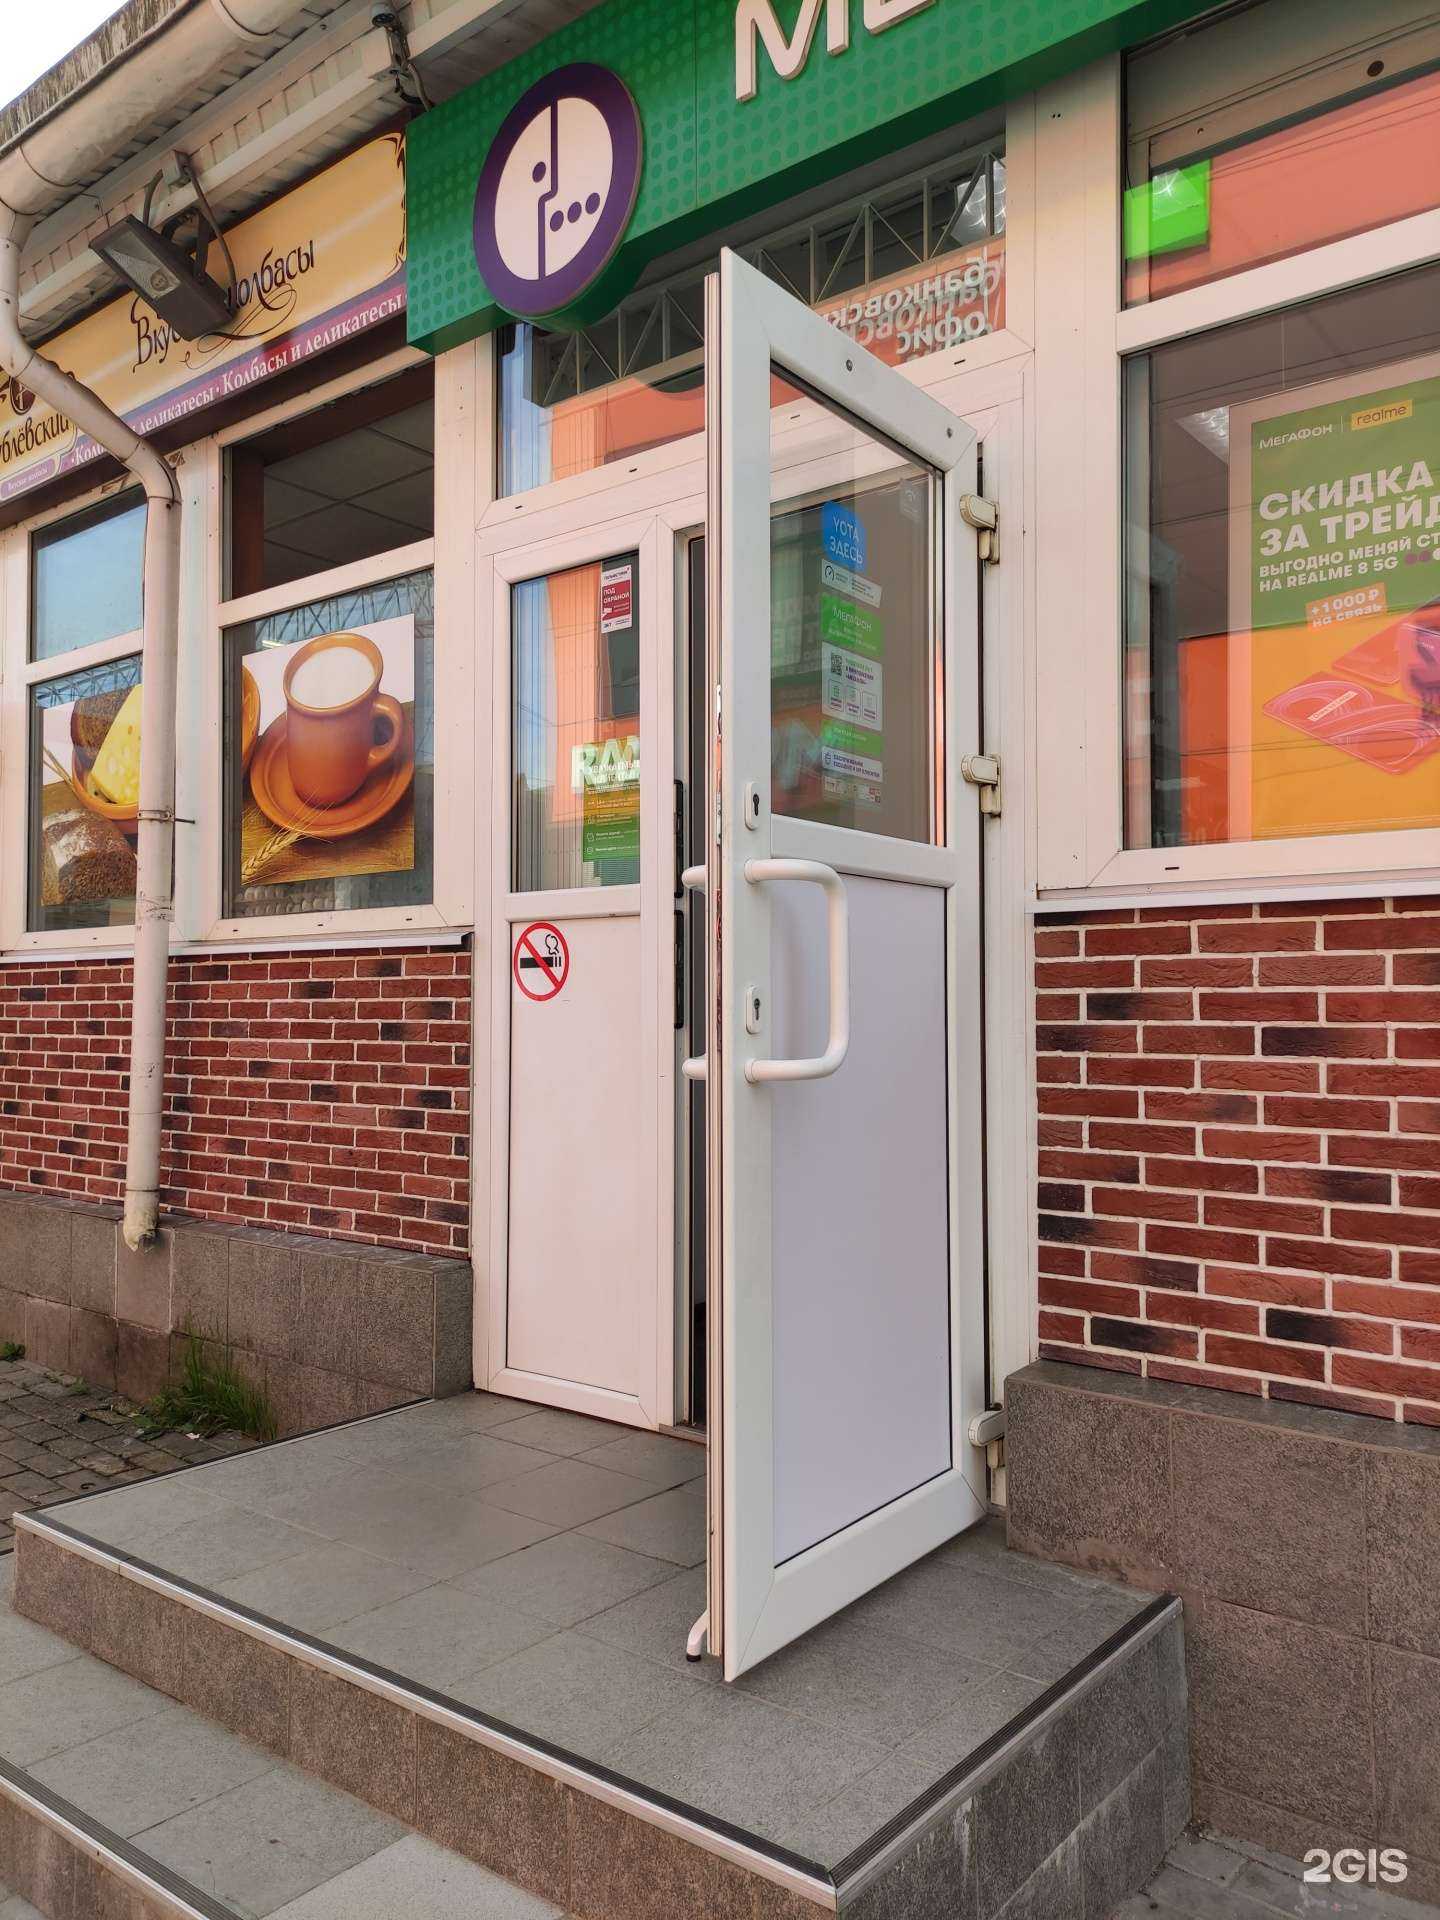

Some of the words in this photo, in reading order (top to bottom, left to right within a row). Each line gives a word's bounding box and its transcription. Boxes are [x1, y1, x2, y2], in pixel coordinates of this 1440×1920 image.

[222, 351, 289, 396] Колбасы
[291, 343, 303, 362] и
[305, 293, 403, 356] деликатесы
[1259, 423, 1334, 450] МЕГАФОН
[1356, 404, 1407, 426] realme
[1259, 460, 1434, 520] СКИДКА
[832, 511, 860, 543] YOTA
[1260, 523, 1310, 556] ЗА
[829, 536, 864, 564] ЗДЕСЬ
[1259, 551, 1344, 578] ВЫГОДНО
[1348, 536, 1412, 561] МЕНЯЙ
[1259, 577, 1282, 592] НА
[1286, 563, 1353, 588] REALME
[1357, 561, 1369, 574] 8
[1373, 556, 1399, 572] 5G
[1312, 615, 1332, 628] на
[1336, 604, 1383, 622] связь
